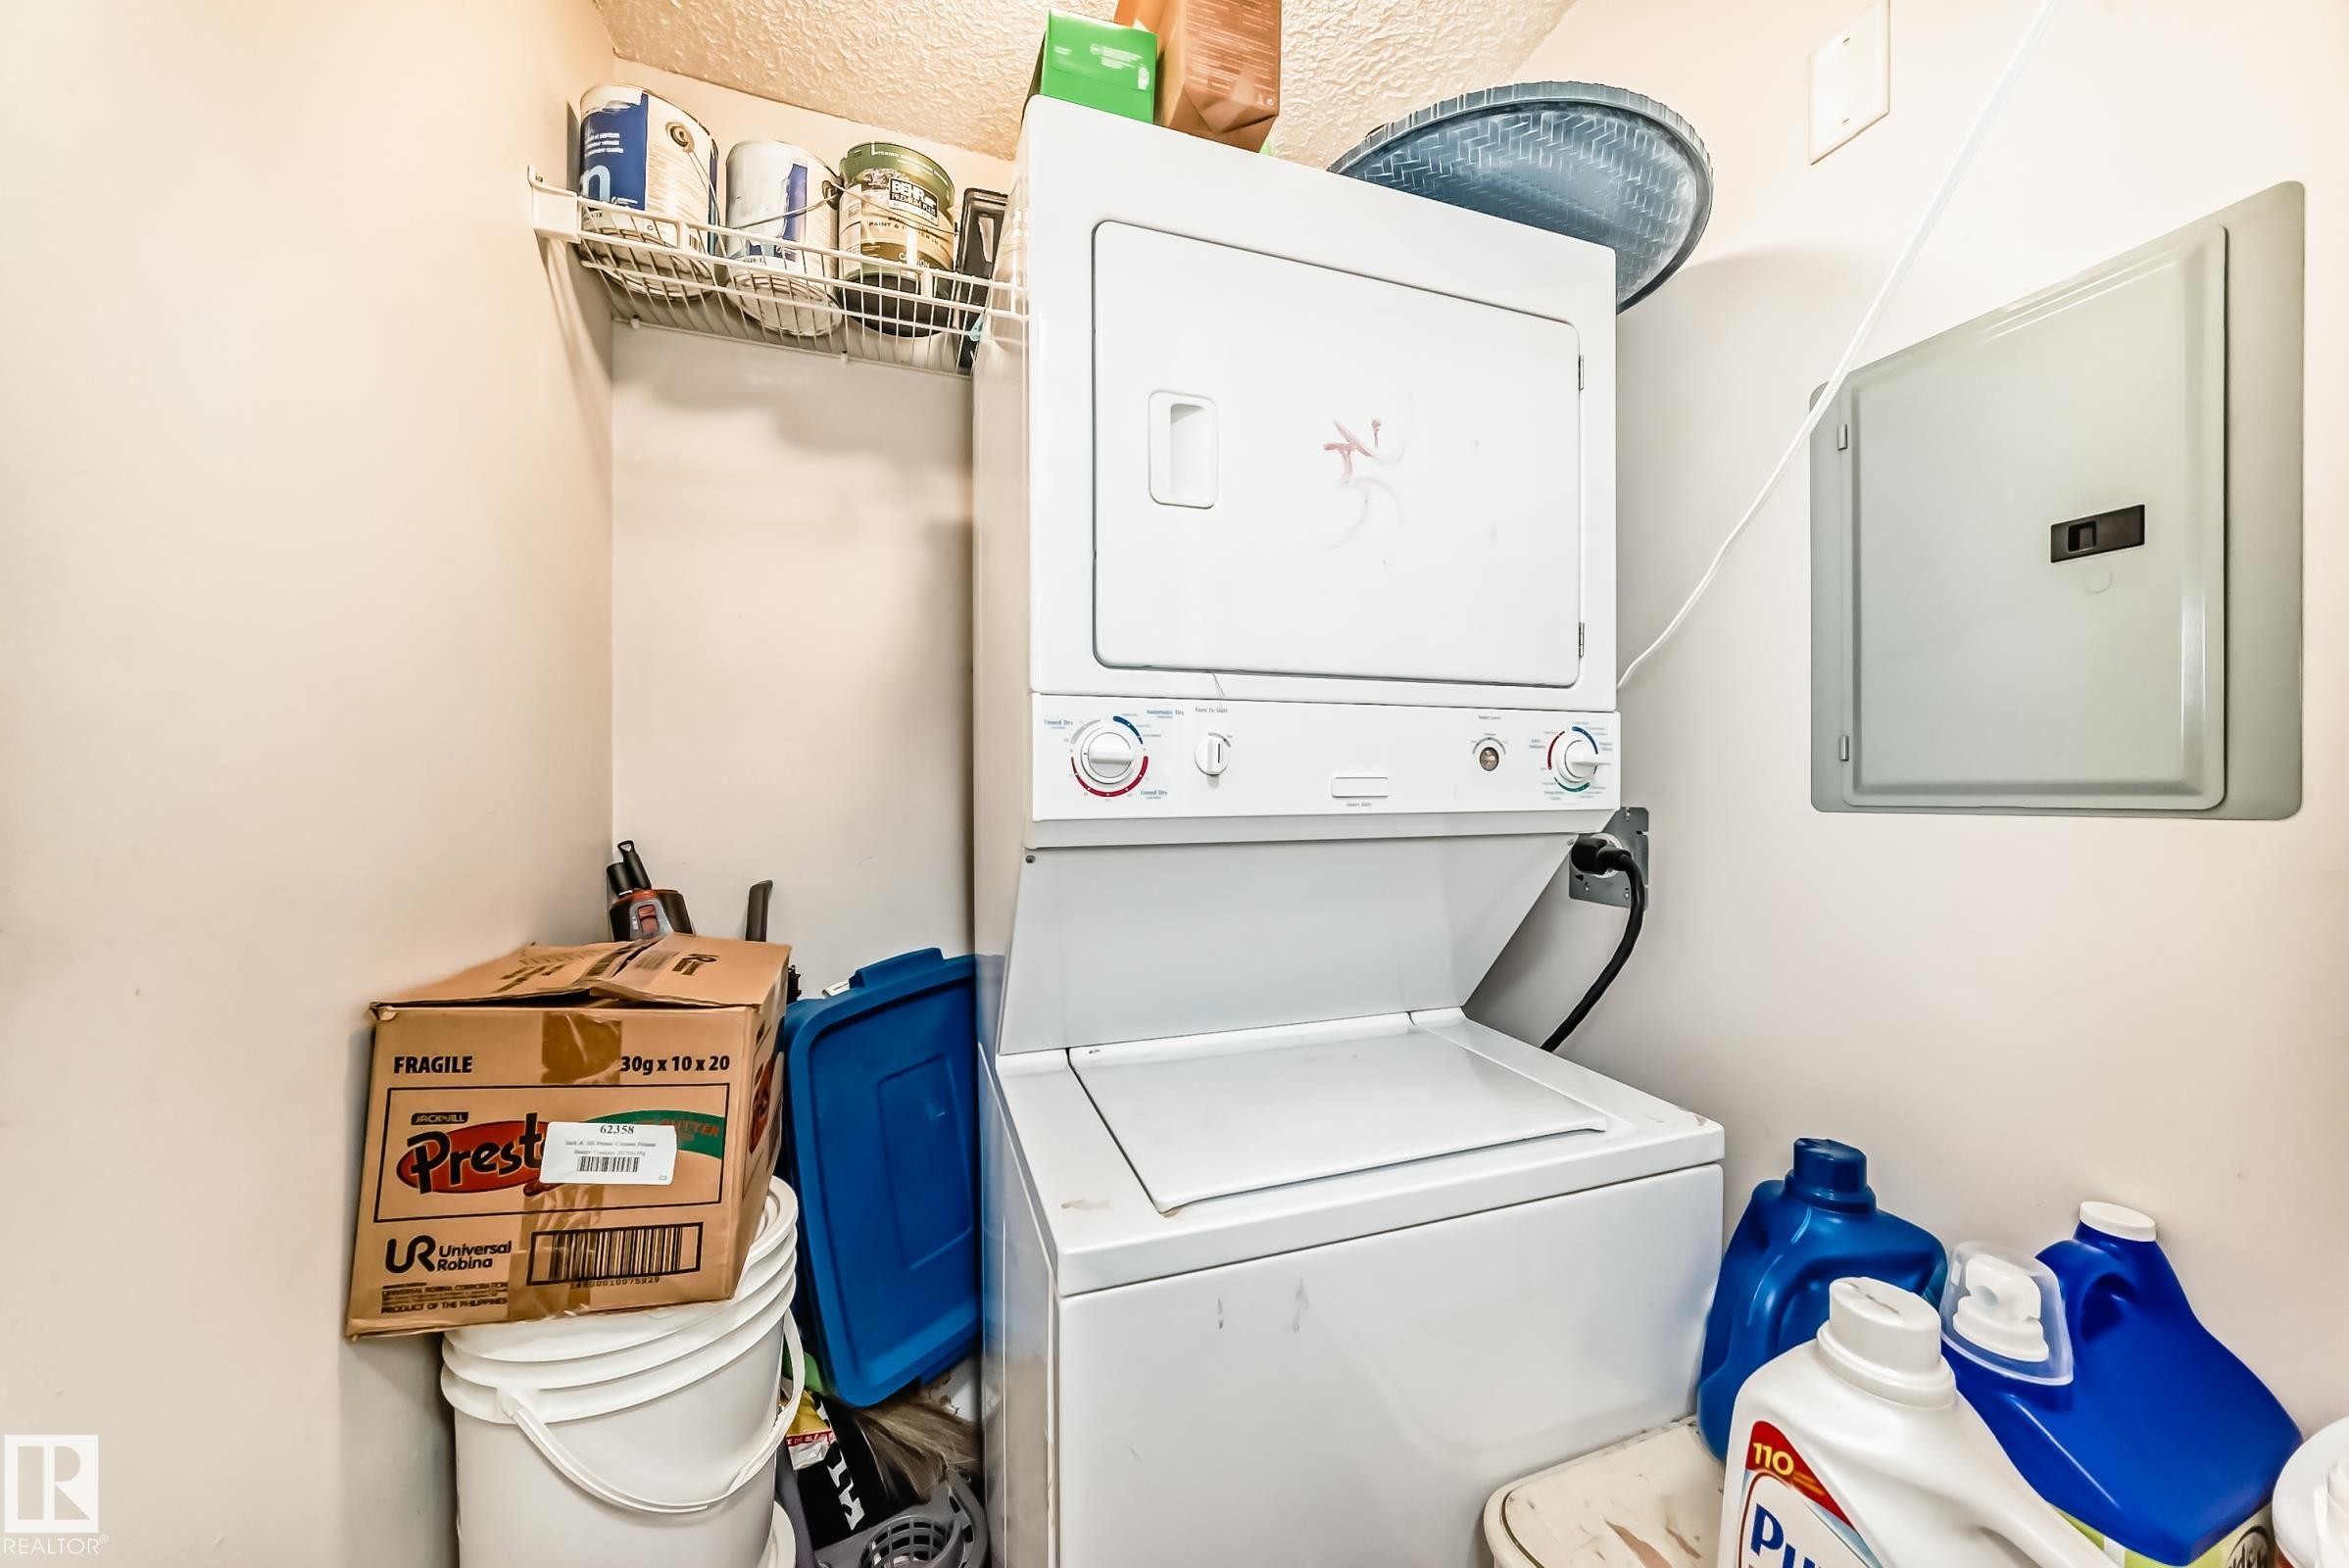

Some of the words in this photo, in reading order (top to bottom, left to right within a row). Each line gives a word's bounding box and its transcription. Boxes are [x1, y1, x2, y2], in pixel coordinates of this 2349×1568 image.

[892, 179, 925, 200] BEHR
[892, 193, 922, 208] PREMIUM
[393, 1054, 473, 1074] FRAGILE
[620, 1055, 654, 1076] 30g
[657, 1058, 668, 1071] x
[671, 1055, 692, 1071] 10
[694, 1058, 706, 1071] x
[709, 1054, 730, 1071] 20
[600, 1124, 635, 1135] 62358
[407, 1112, 545, 1195] Prest
[438, 1240, 513, 1257] Universal
[437, 1256, 494, 1272] Robina
[380, 1303, 424, 1314] PRODUCT
[442, 1300, 458, 1309] THE
[1752, 1442, 1794, 1477] 110
